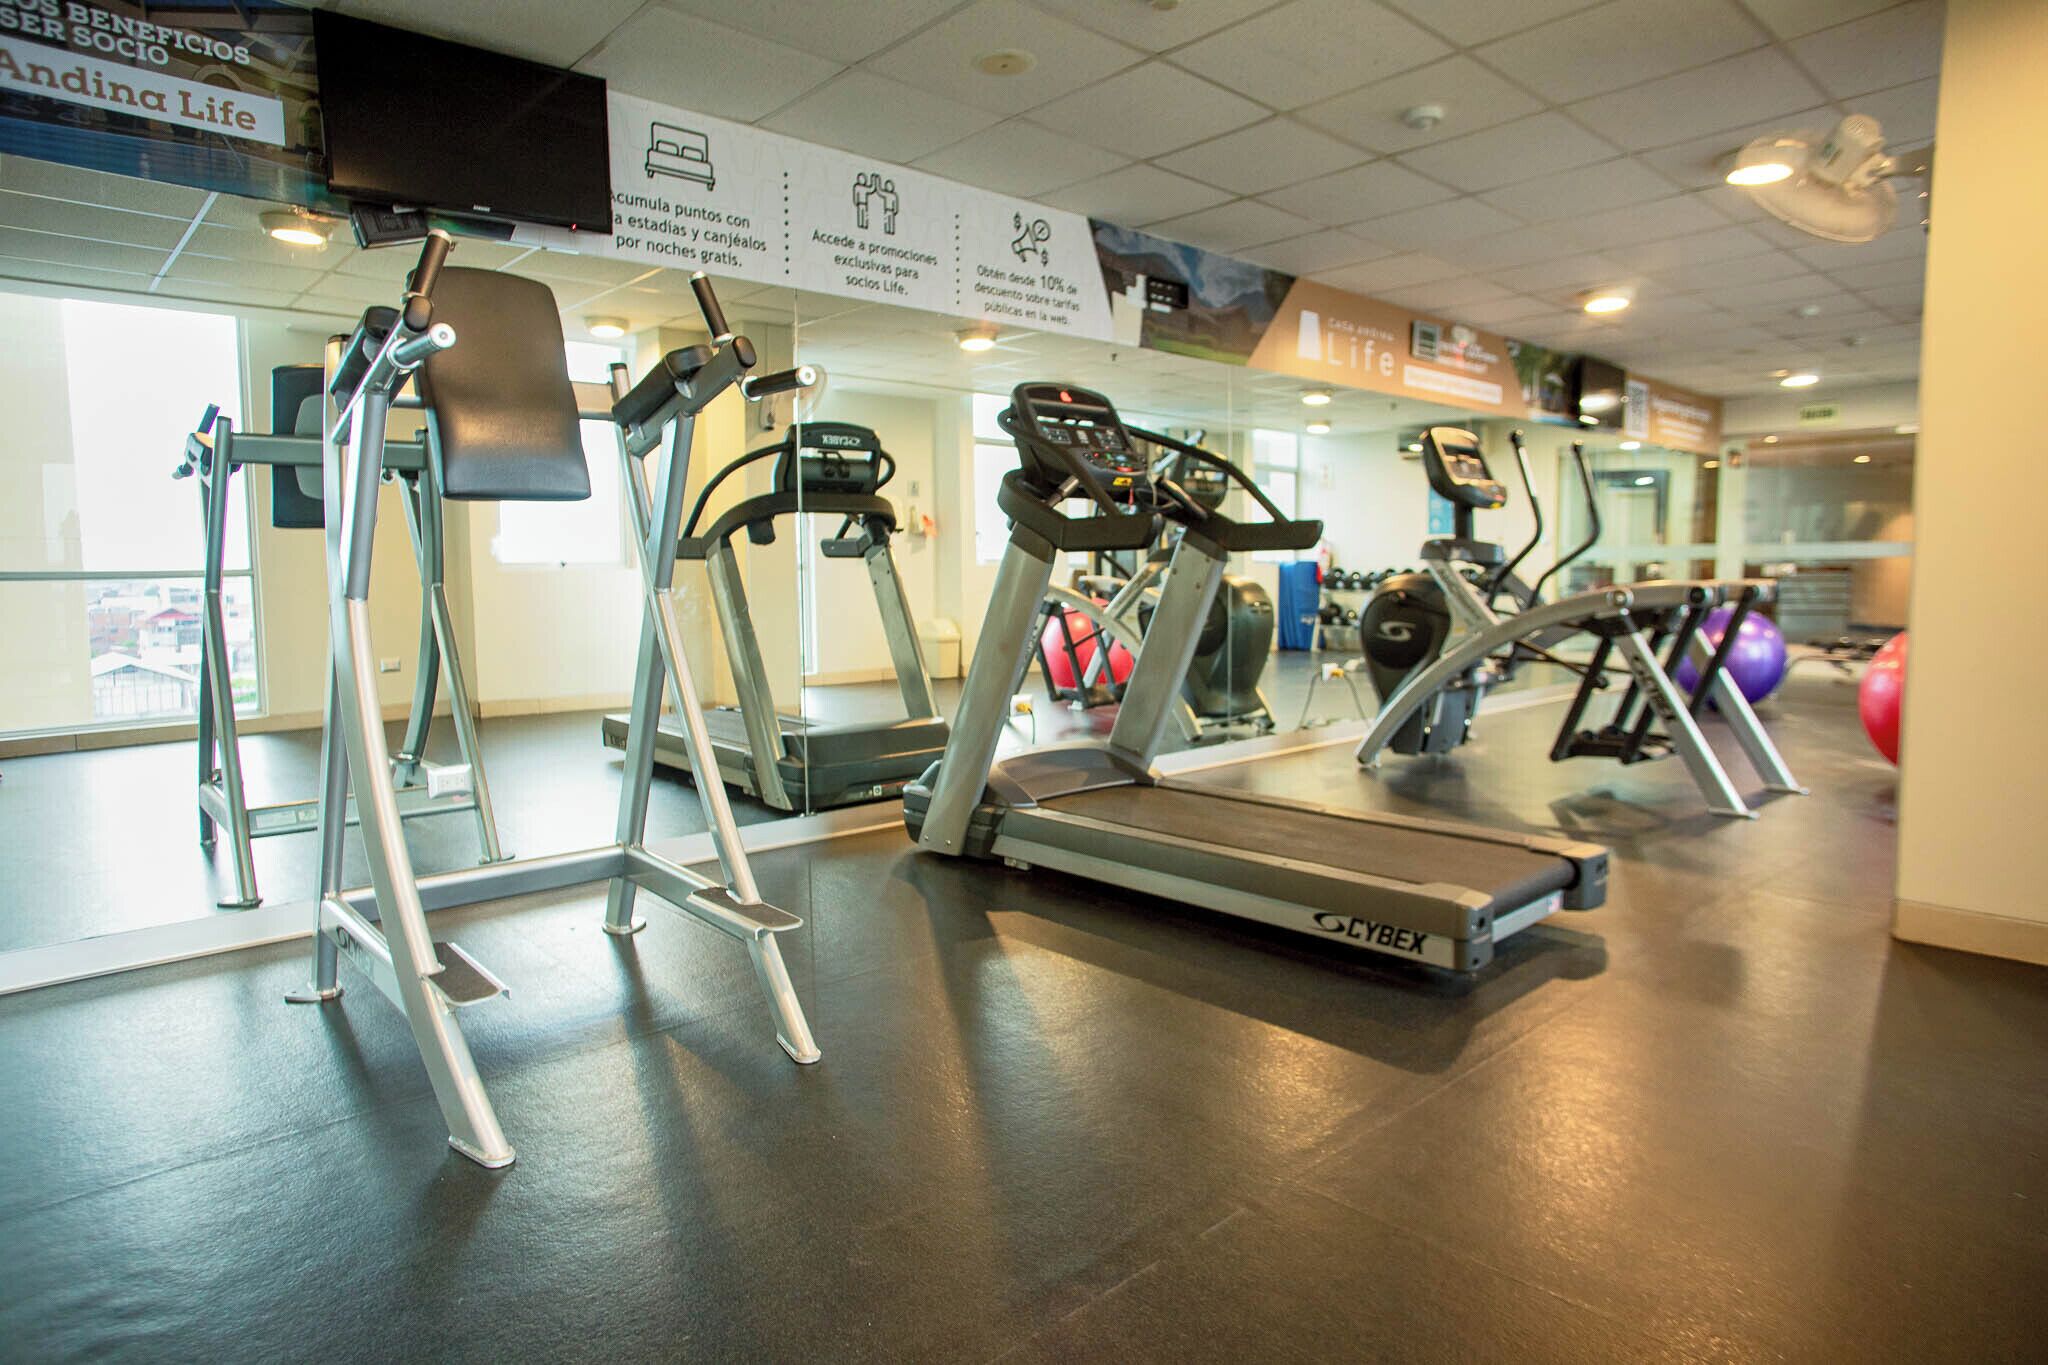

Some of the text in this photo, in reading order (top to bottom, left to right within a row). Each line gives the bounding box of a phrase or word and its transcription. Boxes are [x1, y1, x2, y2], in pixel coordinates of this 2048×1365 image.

[0, 0, 250, 65] OS BENEFICIOS
[0, 7, 169, 65] SER SOCIO
[0, 48, 256, 131] Andina Life
[628, 215, 687, 237] estadías
[691, 227, 699, 242] y
[704, 228, 767, 251] canjéalos
[675, 203, 722, 224] puntos
[726, 214, 750, 229] con
[616, 234, 742, 267] por noches gratis.
[812, 229, 938, 266] Accede a promociones
[834, 254, 919, 280] exclusivas para
[1008, 272, 1036, 287] desde
[1041, 275, 1064, 293] 10%
[1066, 284, 1078, 295] de
[846, 274, 909, 296] socios Life.
[974, 281, 1080, 312] descuento sobre tarifas
[1025, 309, 1036, 319] en
[1039, 310, 1047, 321] la
[1327, 331, 1395, 377] Life
[1346, 917, 1427, 955] CYBEX
